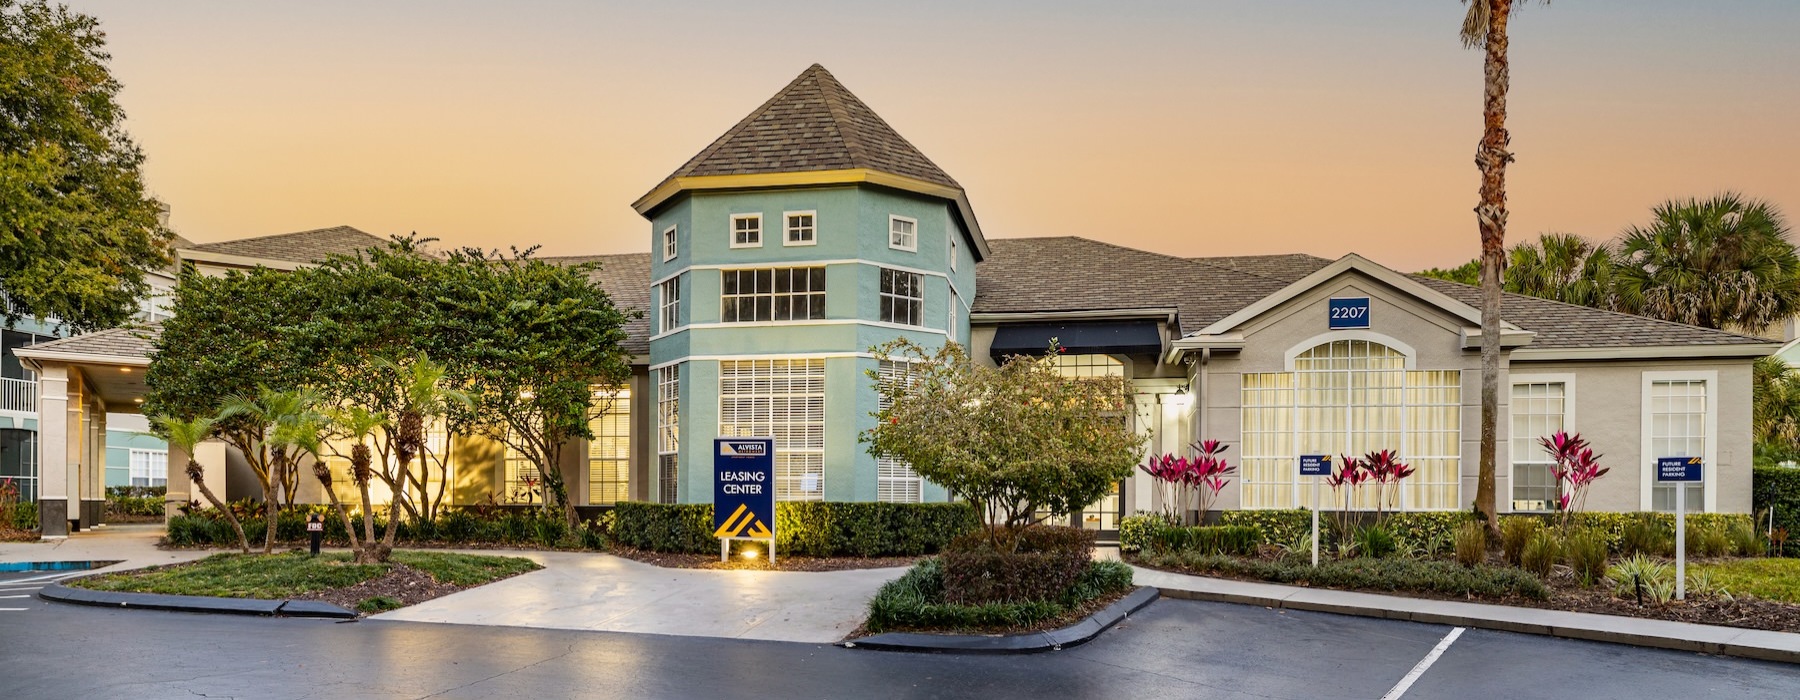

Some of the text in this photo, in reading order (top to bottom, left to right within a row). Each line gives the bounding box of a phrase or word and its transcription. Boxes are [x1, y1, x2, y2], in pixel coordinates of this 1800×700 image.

[1331, 306, 1368, 319] 2207
[720, 472, 766, 482] LEASING
[723, 484, 762, 494] CENTER
